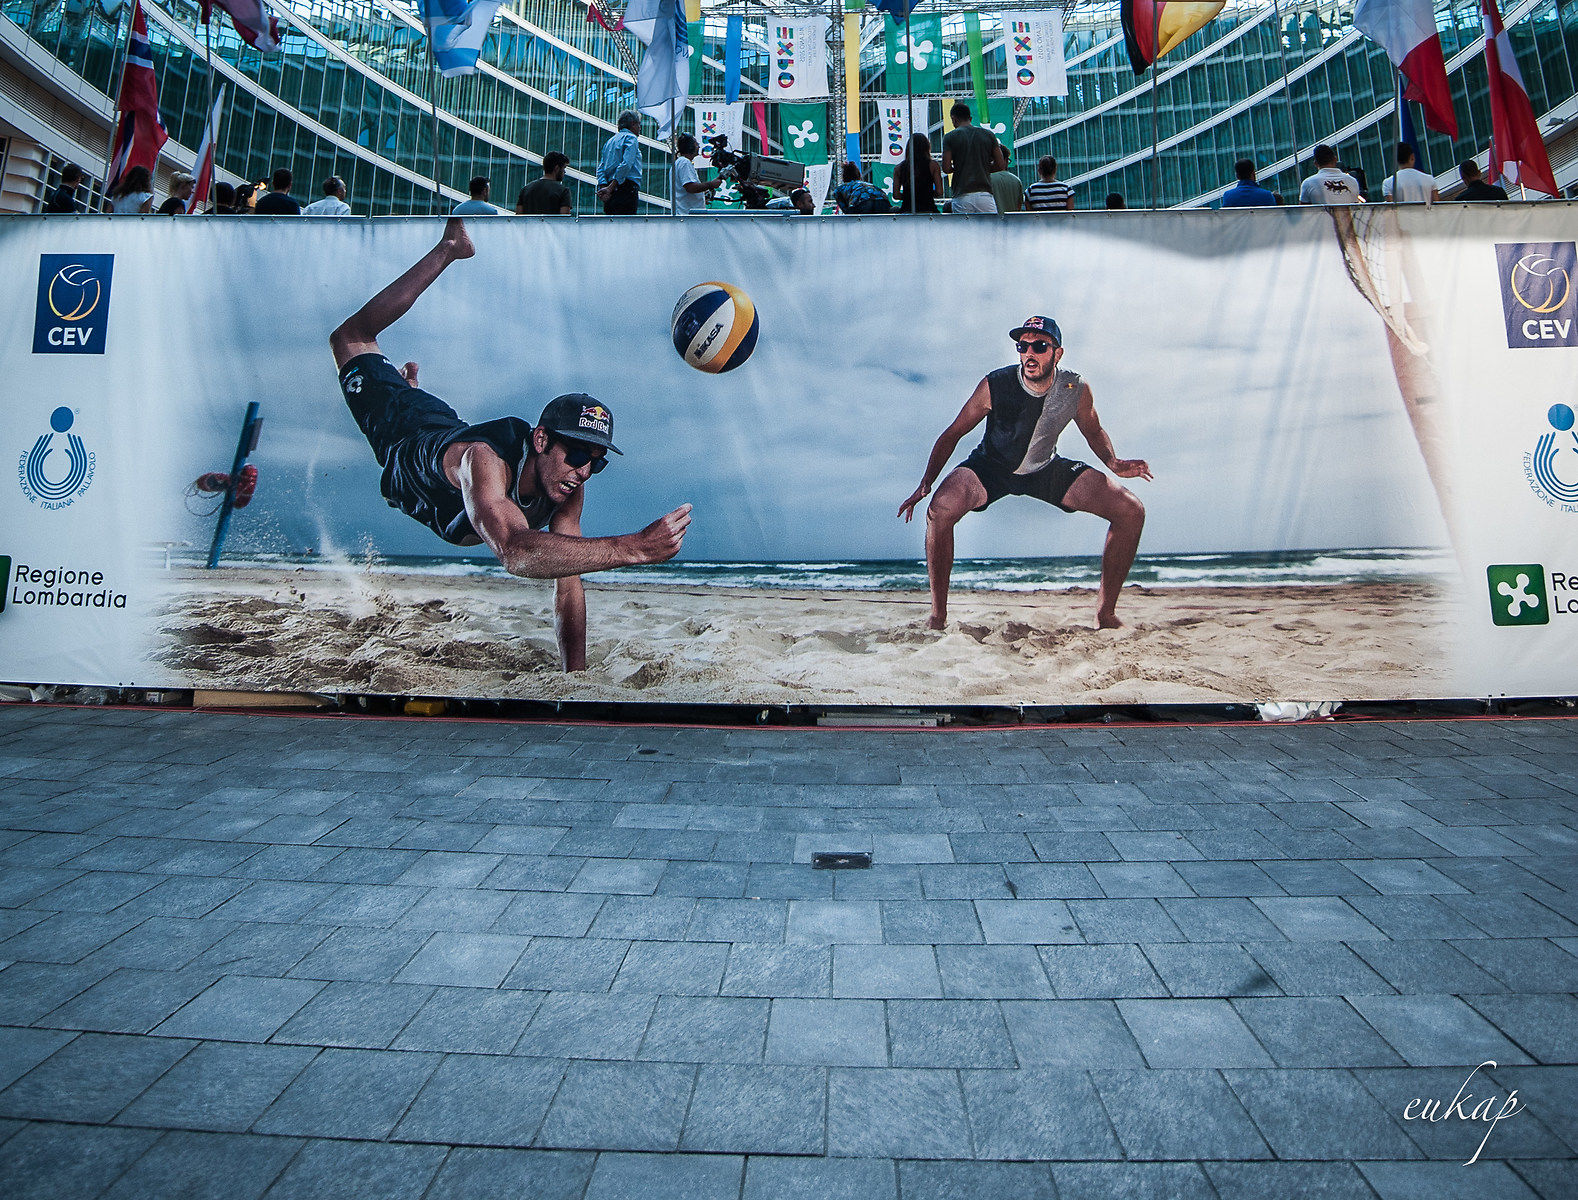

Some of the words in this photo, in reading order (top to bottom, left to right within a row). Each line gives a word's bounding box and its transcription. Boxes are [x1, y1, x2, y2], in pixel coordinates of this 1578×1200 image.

[47, 326, 94, 346] CEV
[1522, 319, 1572, 340] CEV
[18, 450, 38, 504] FEDERAZIONE
[40, 498, 75, 511] ITALIANA
[77, 451, 97, 497] PALLAVOLO
[1522, 451, 1556, 508] FEDERAZIONE
[15, 565, 104, 588] Regione
[12, 586, 127, 609] Lombardia
